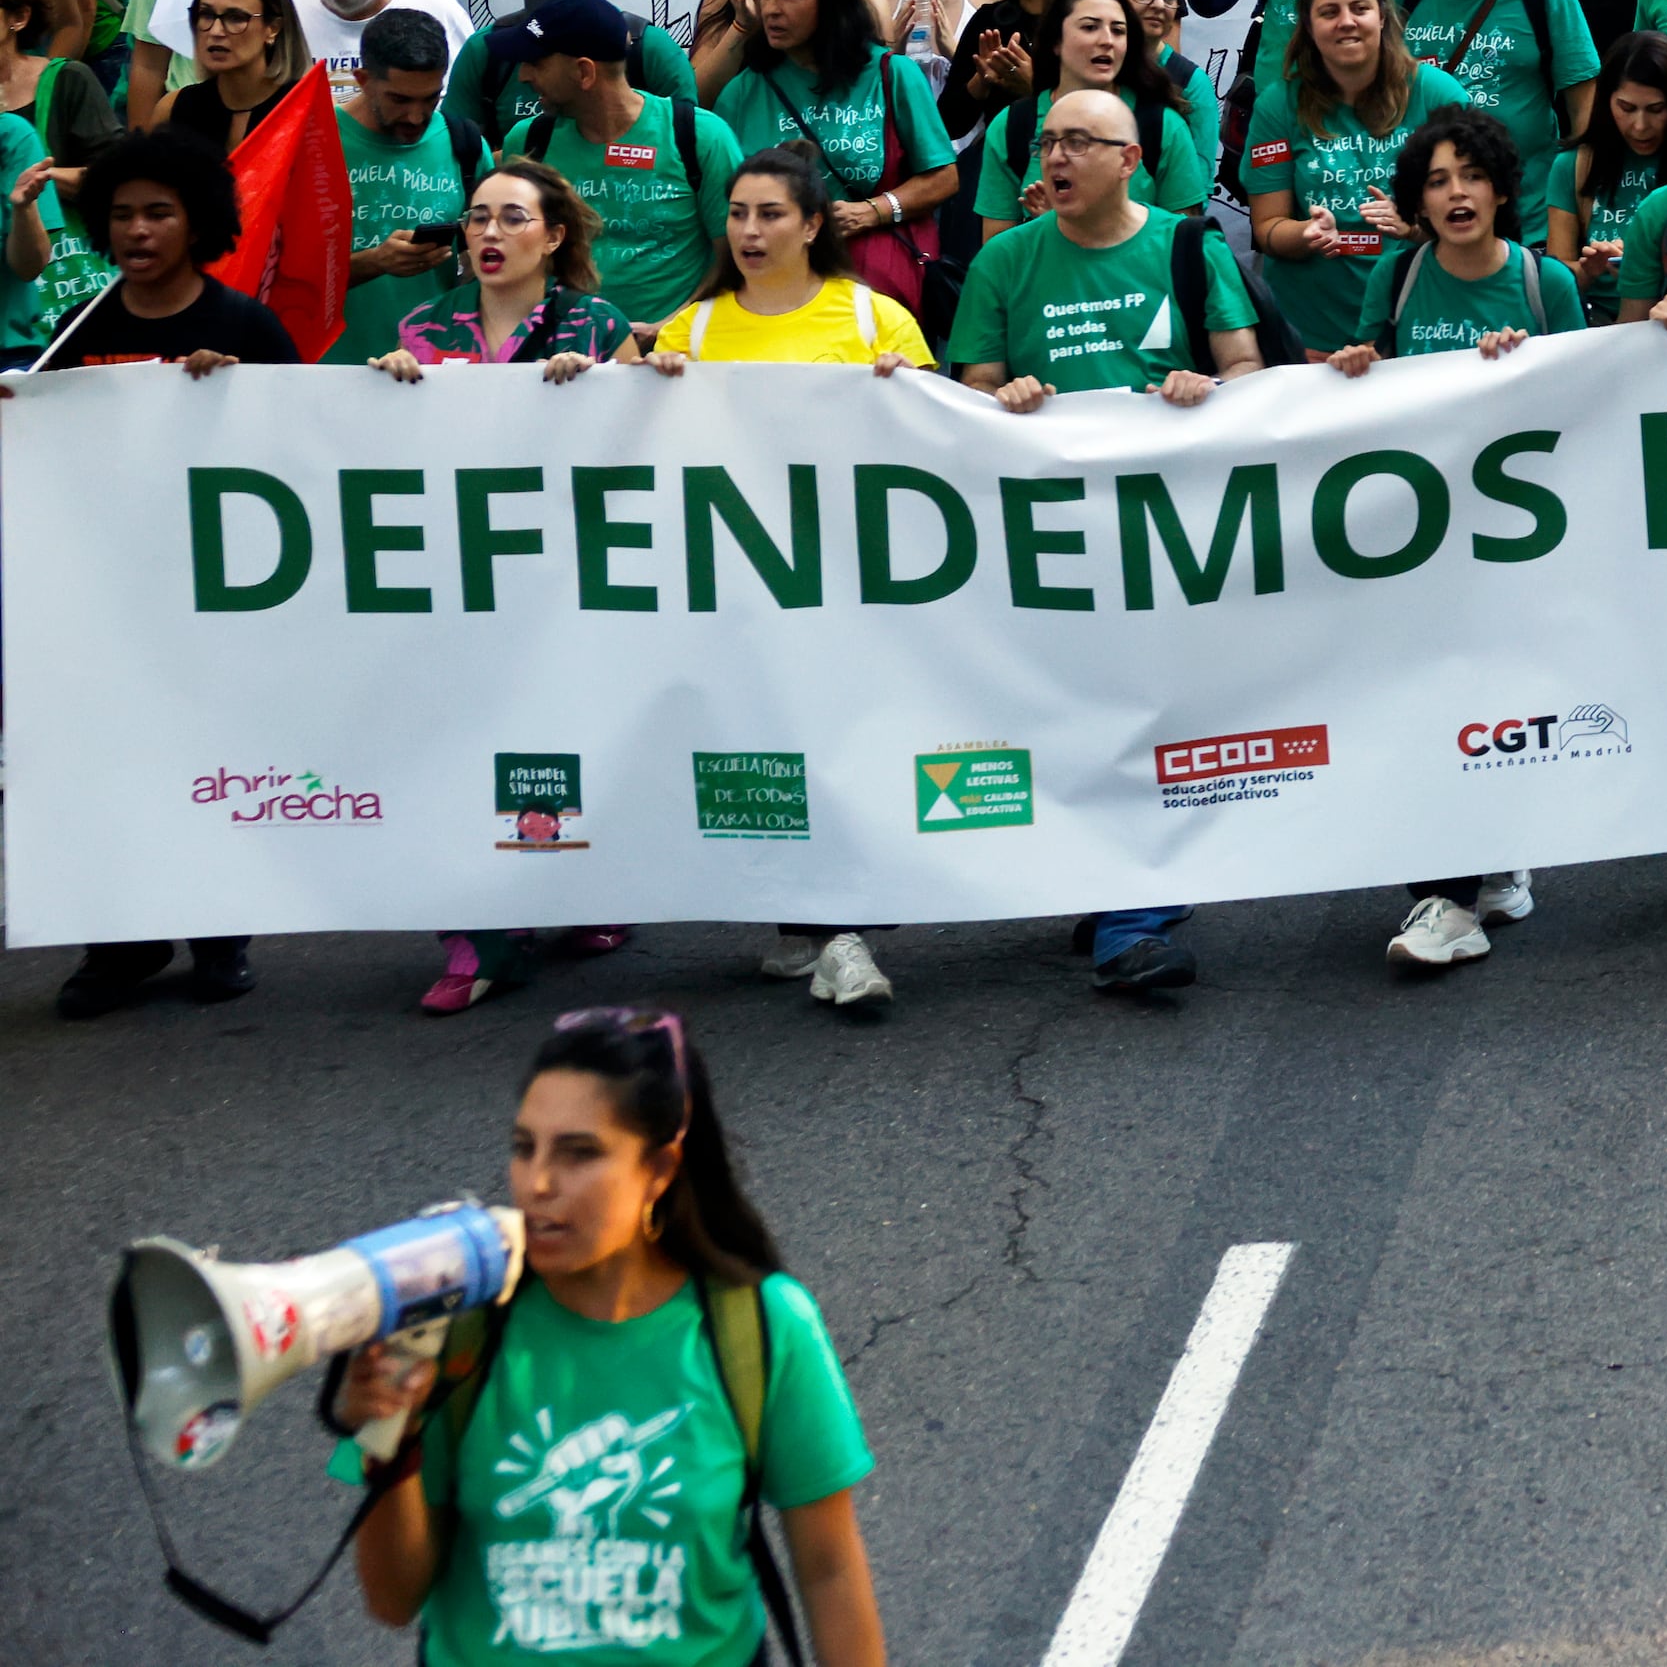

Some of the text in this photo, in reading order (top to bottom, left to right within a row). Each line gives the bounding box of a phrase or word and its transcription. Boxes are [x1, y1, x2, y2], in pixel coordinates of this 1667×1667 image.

[607, 145, 653, 160] CCOO
[1043, 293, 1146, 319] Queremos FP
[1046, 321, 1107, 340] de todas
[1049, 338, 1124, 362] para todas
[188, 428, 1568, 614] DEFENDEMOS
[1457, 714, 1559, 757] CGT
[970, 760, 1014, 774] MENOS
[1164, 739, 1275, 777] CCOO
[1462, 743, 1634, 772] Enseñanza Madrid
[965, 773, 1020, 788] LECTIVAS
[1162, 769, 1315, 796] educación y servicios
[1163, 787, 1280, 808] socioeducativos
